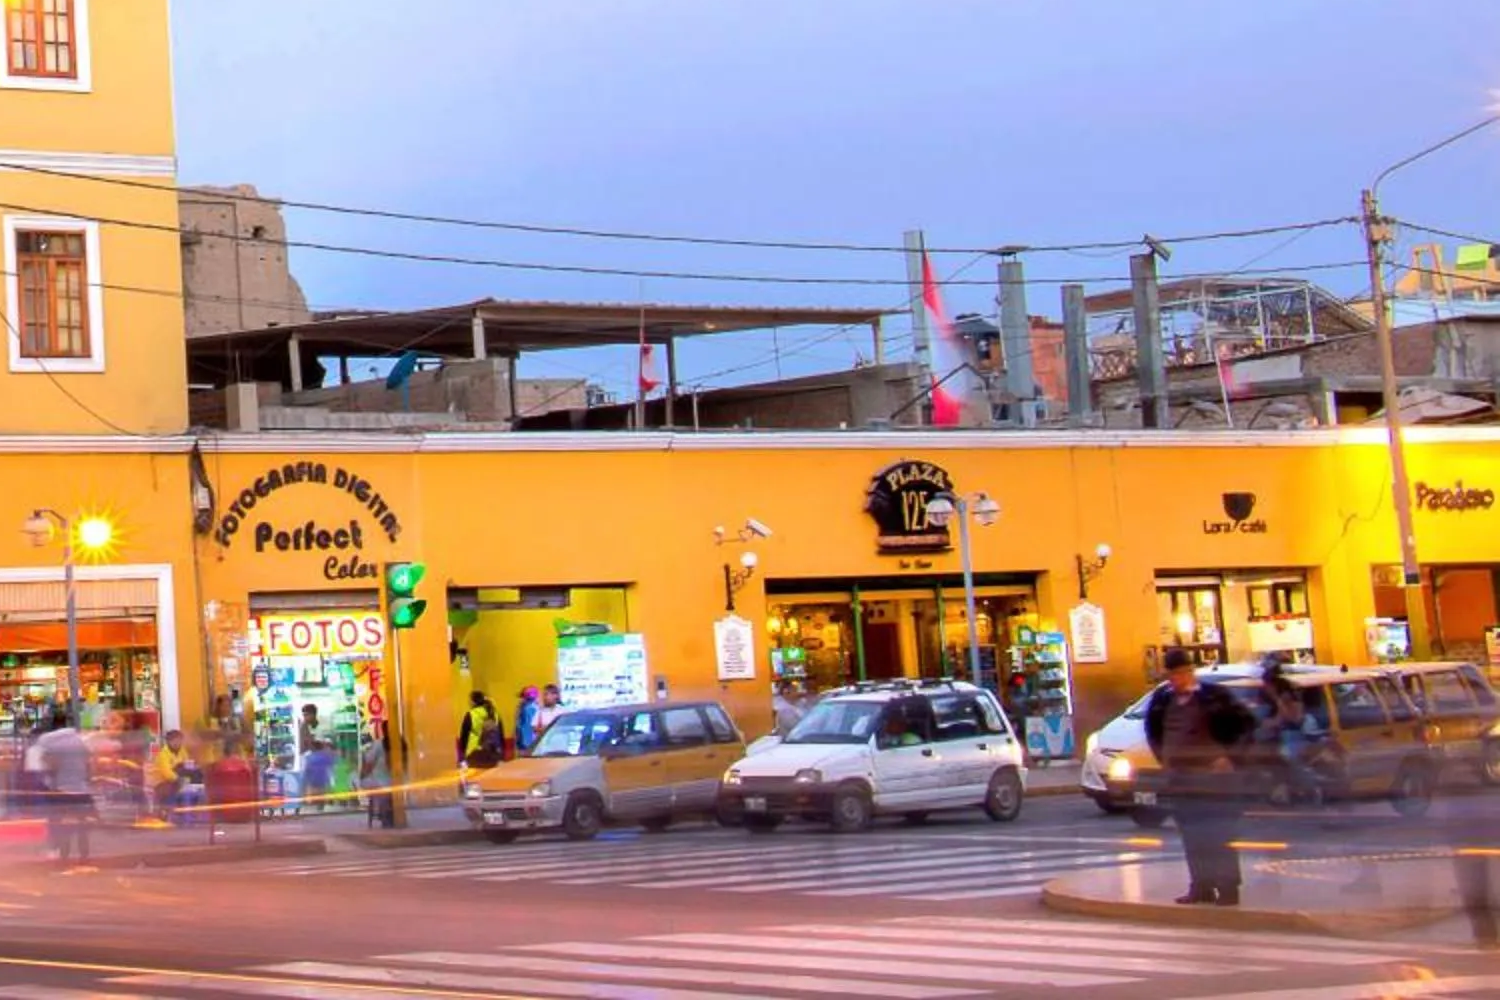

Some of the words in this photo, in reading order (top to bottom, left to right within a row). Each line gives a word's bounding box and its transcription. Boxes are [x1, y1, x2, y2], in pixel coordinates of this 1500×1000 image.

[886, 464, 946, 492] PLAZA
[255, 519, 364, 552] Perfect
[323, 554, 379, 581] Color
[268, 617, 384, 650] FOTOS
[366, 668, 385, 740] FOT
